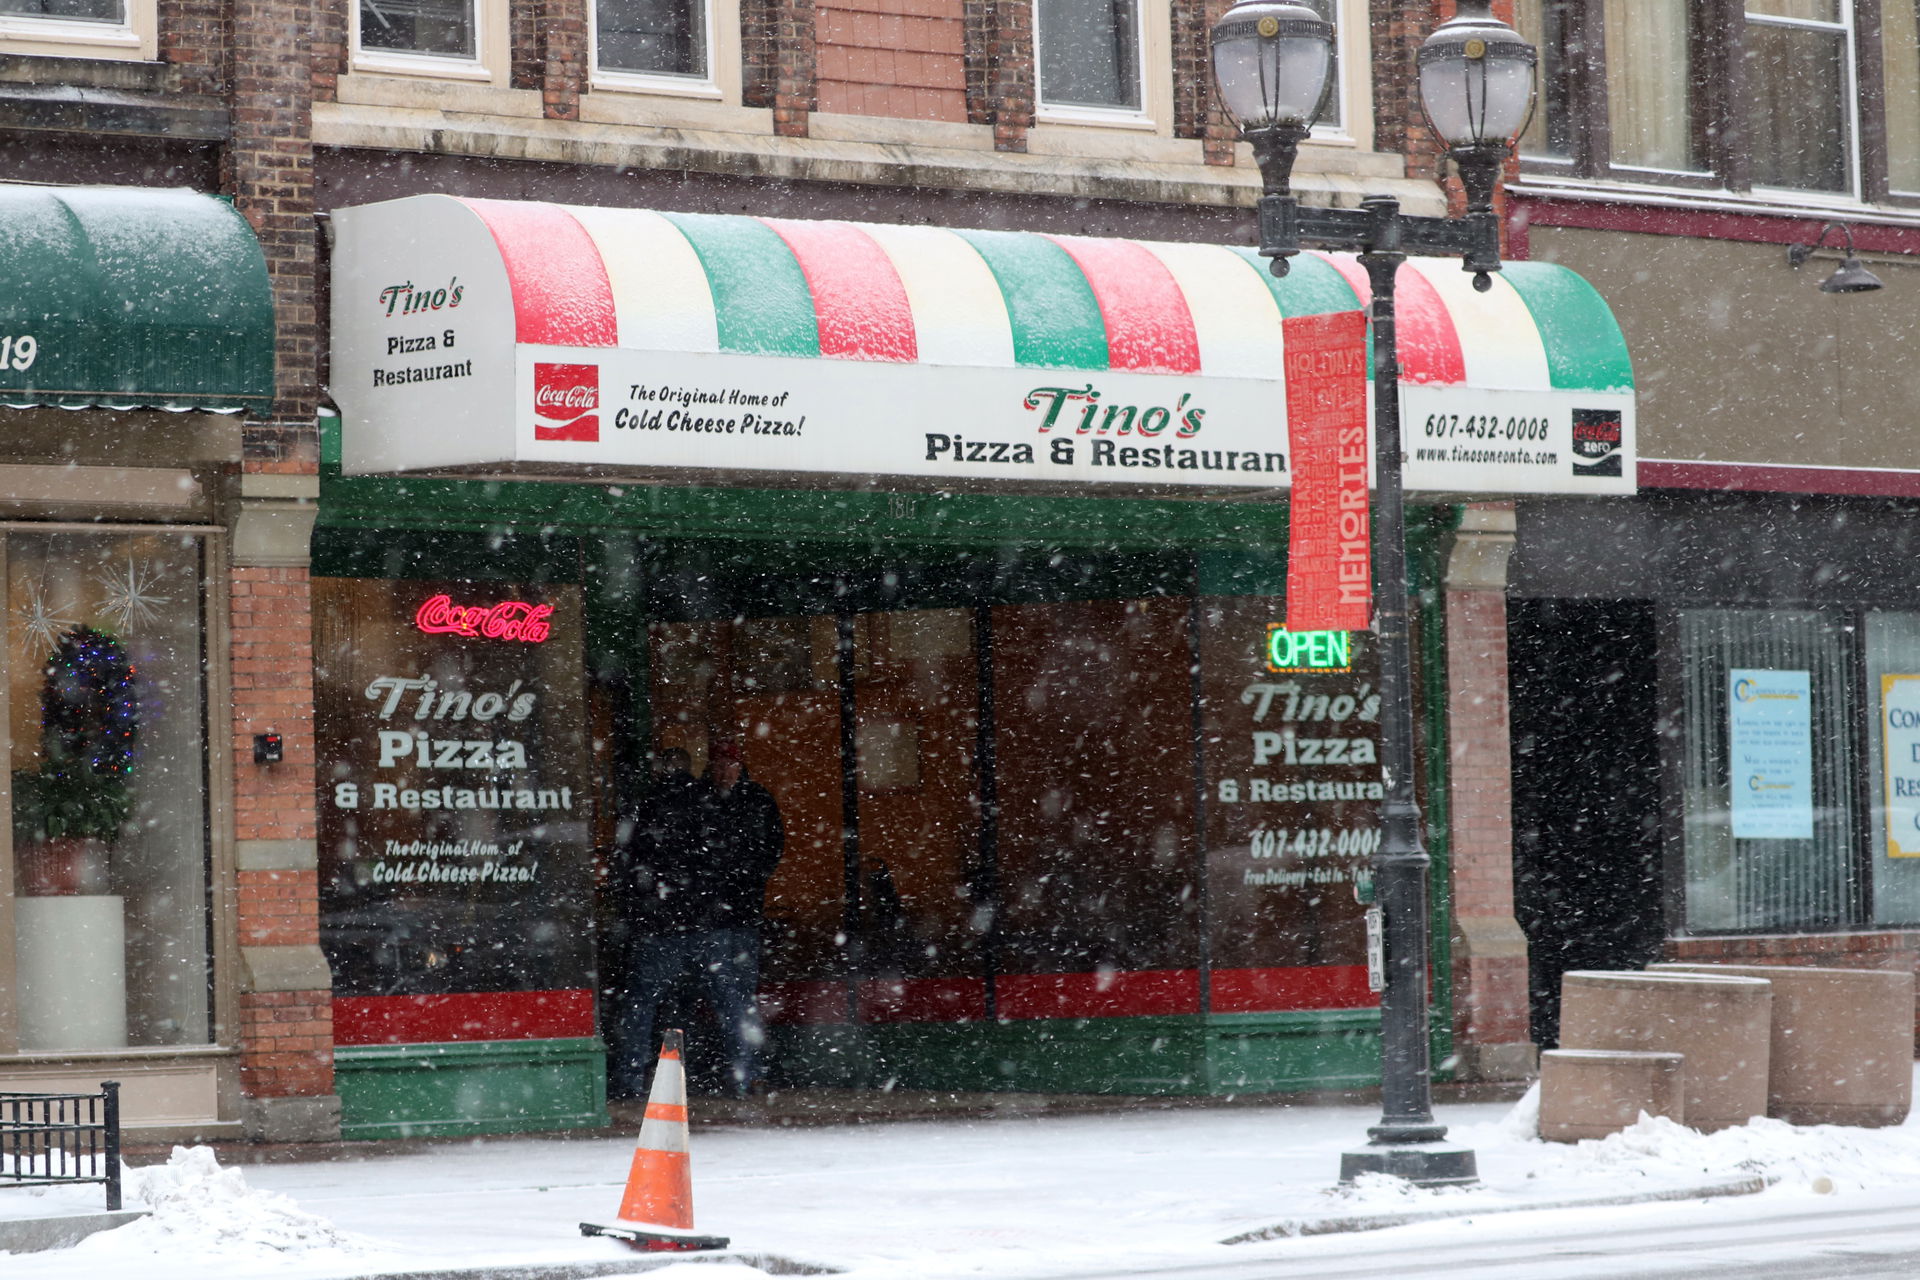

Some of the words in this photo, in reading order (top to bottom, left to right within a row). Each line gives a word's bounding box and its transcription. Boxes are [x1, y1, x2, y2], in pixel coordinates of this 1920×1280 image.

[379, 276, 464, 317] Tino's
[387, 336, 436, 355] Pizza
[443, 329, 455, 347] &
[373, 359, 472, 387] Restaurant
[536, 385, 598, 408] Coca-Cola
[630, 384, 656, 400] The
[659, 386, 725, 408] Original
[728, 389, 769, 407] Home
[772, 391, 789, 407] of
[615, 407, 663, 430] Cold
[666, 410, 736, 433] Cheese
[740, 413, 806, 436] Pizza!
[1023, 383, 1207, 439] Tino's
[1425, 414, 1549, 440] 607-432-0008
[925, 433, 1035, 464] Pizza
[1050, 438, 1074, 465] &
[1091, 439, 1287, 473] Restauran
[1584, 441, 1610, 453] zero
[1338, 426, 1367, 604] MEMORIES
[416, 594, 555, 642] Coca-Cola
[1271, 628, 1348, 667] OPEN
[365, 673, 536, 721] Tino's
[1241, 681, 1381, 722] Tino's
[378, 731, 528, 769] Pizza
[1252, 731, 1377, 766] Pizza
[334, 782, 359, 809] &
[373, 782, 572, 810] Restaurant
[1218, 779, 1239, 802] &
[1250, 779, 1383, 802] Restaura
[385, 840, 410, 856] The
[410, 840, 468, 860] Original
[508, 840, 523, 856] of
[372, 861, 416, 883] Cold
[417, 861, 477, 883] Cheese
[480, 861, 539, 883] Pizza!
